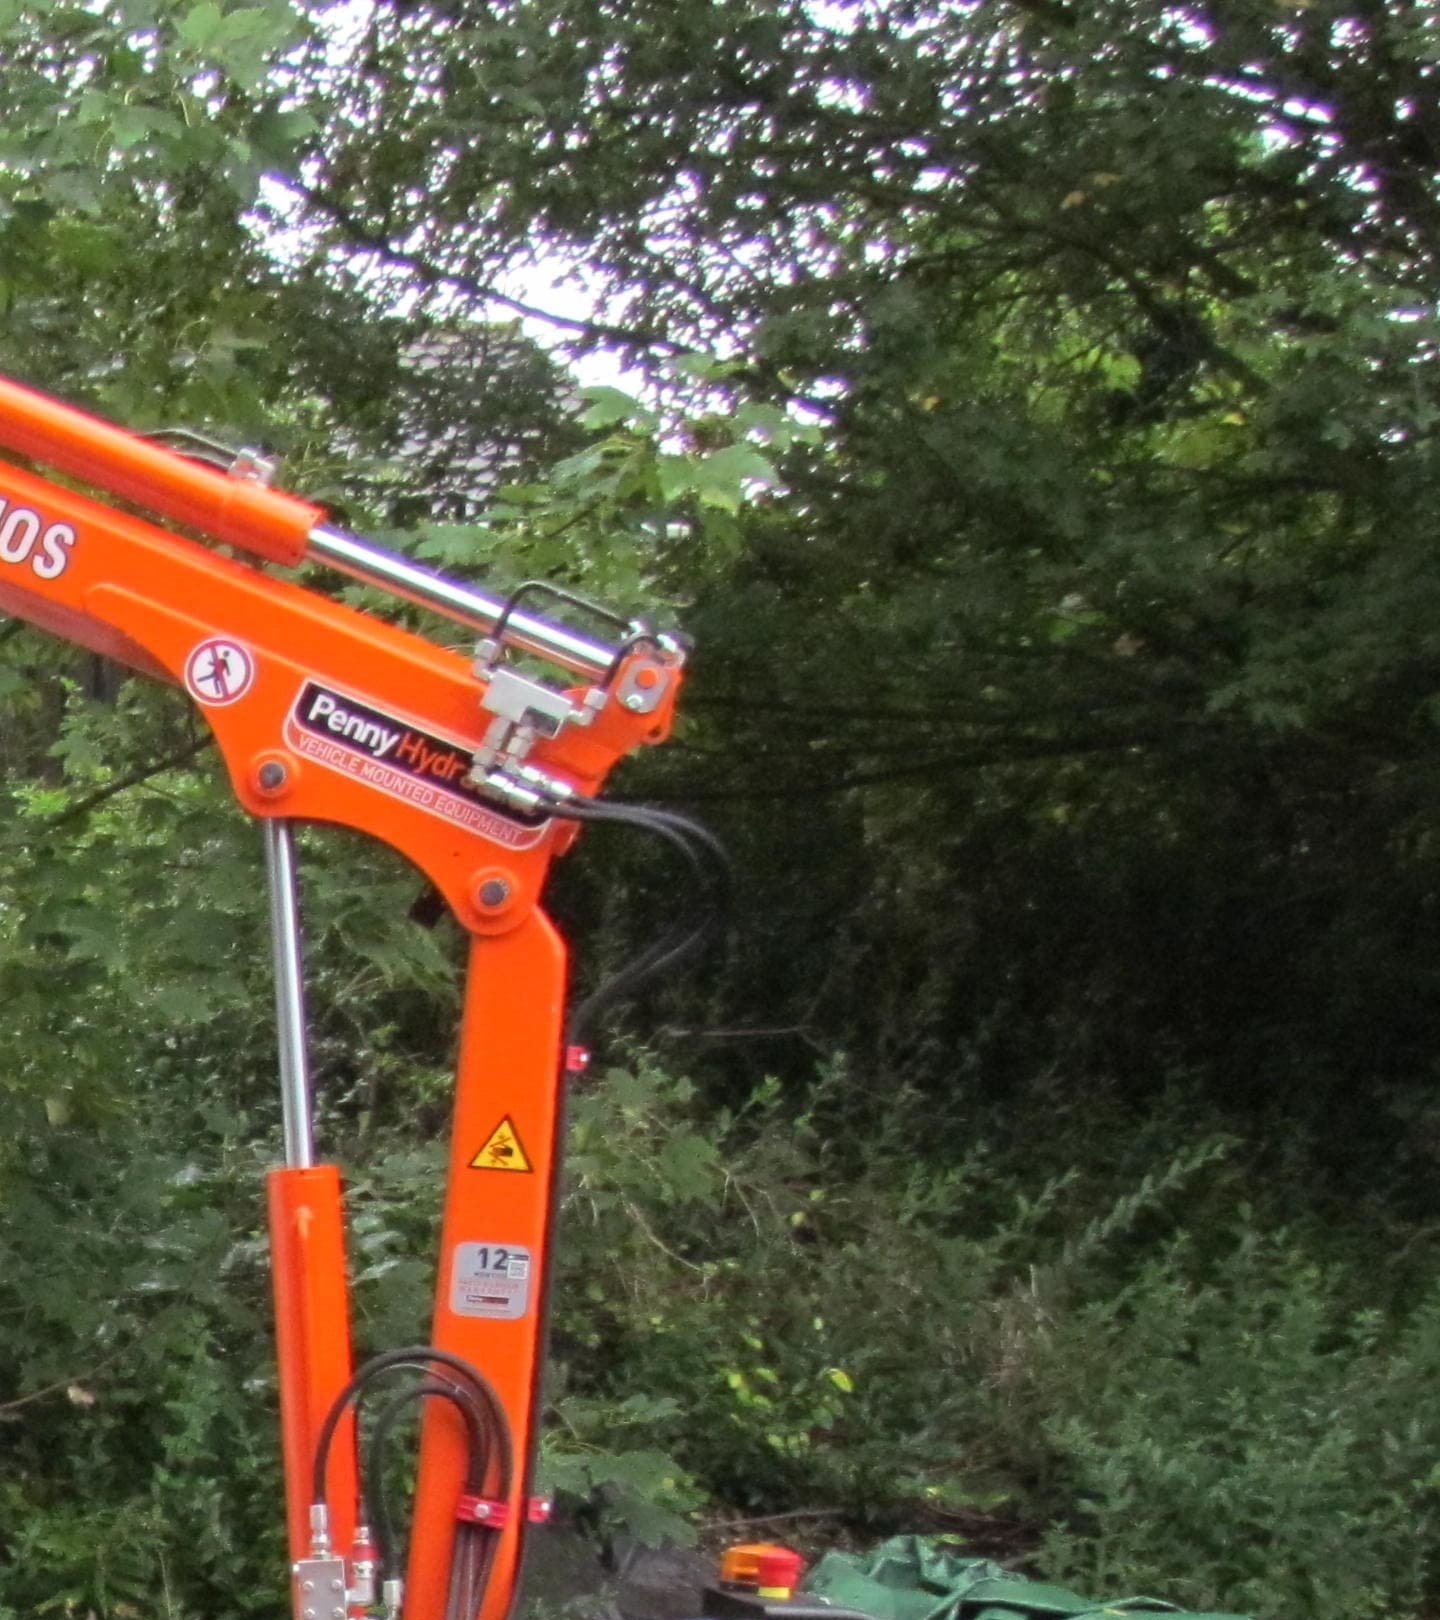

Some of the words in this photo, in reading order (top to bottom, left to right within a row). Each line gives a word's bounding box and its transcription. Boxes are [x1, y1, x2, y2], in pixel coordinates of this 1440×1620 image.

[298, 734, 359, 773] VEHICLE
[360, 765, 437, 805] MOUNTED
[435, 795, 523, 844] EQUIPMENT
[477, 1247, 508, 1270] 12
